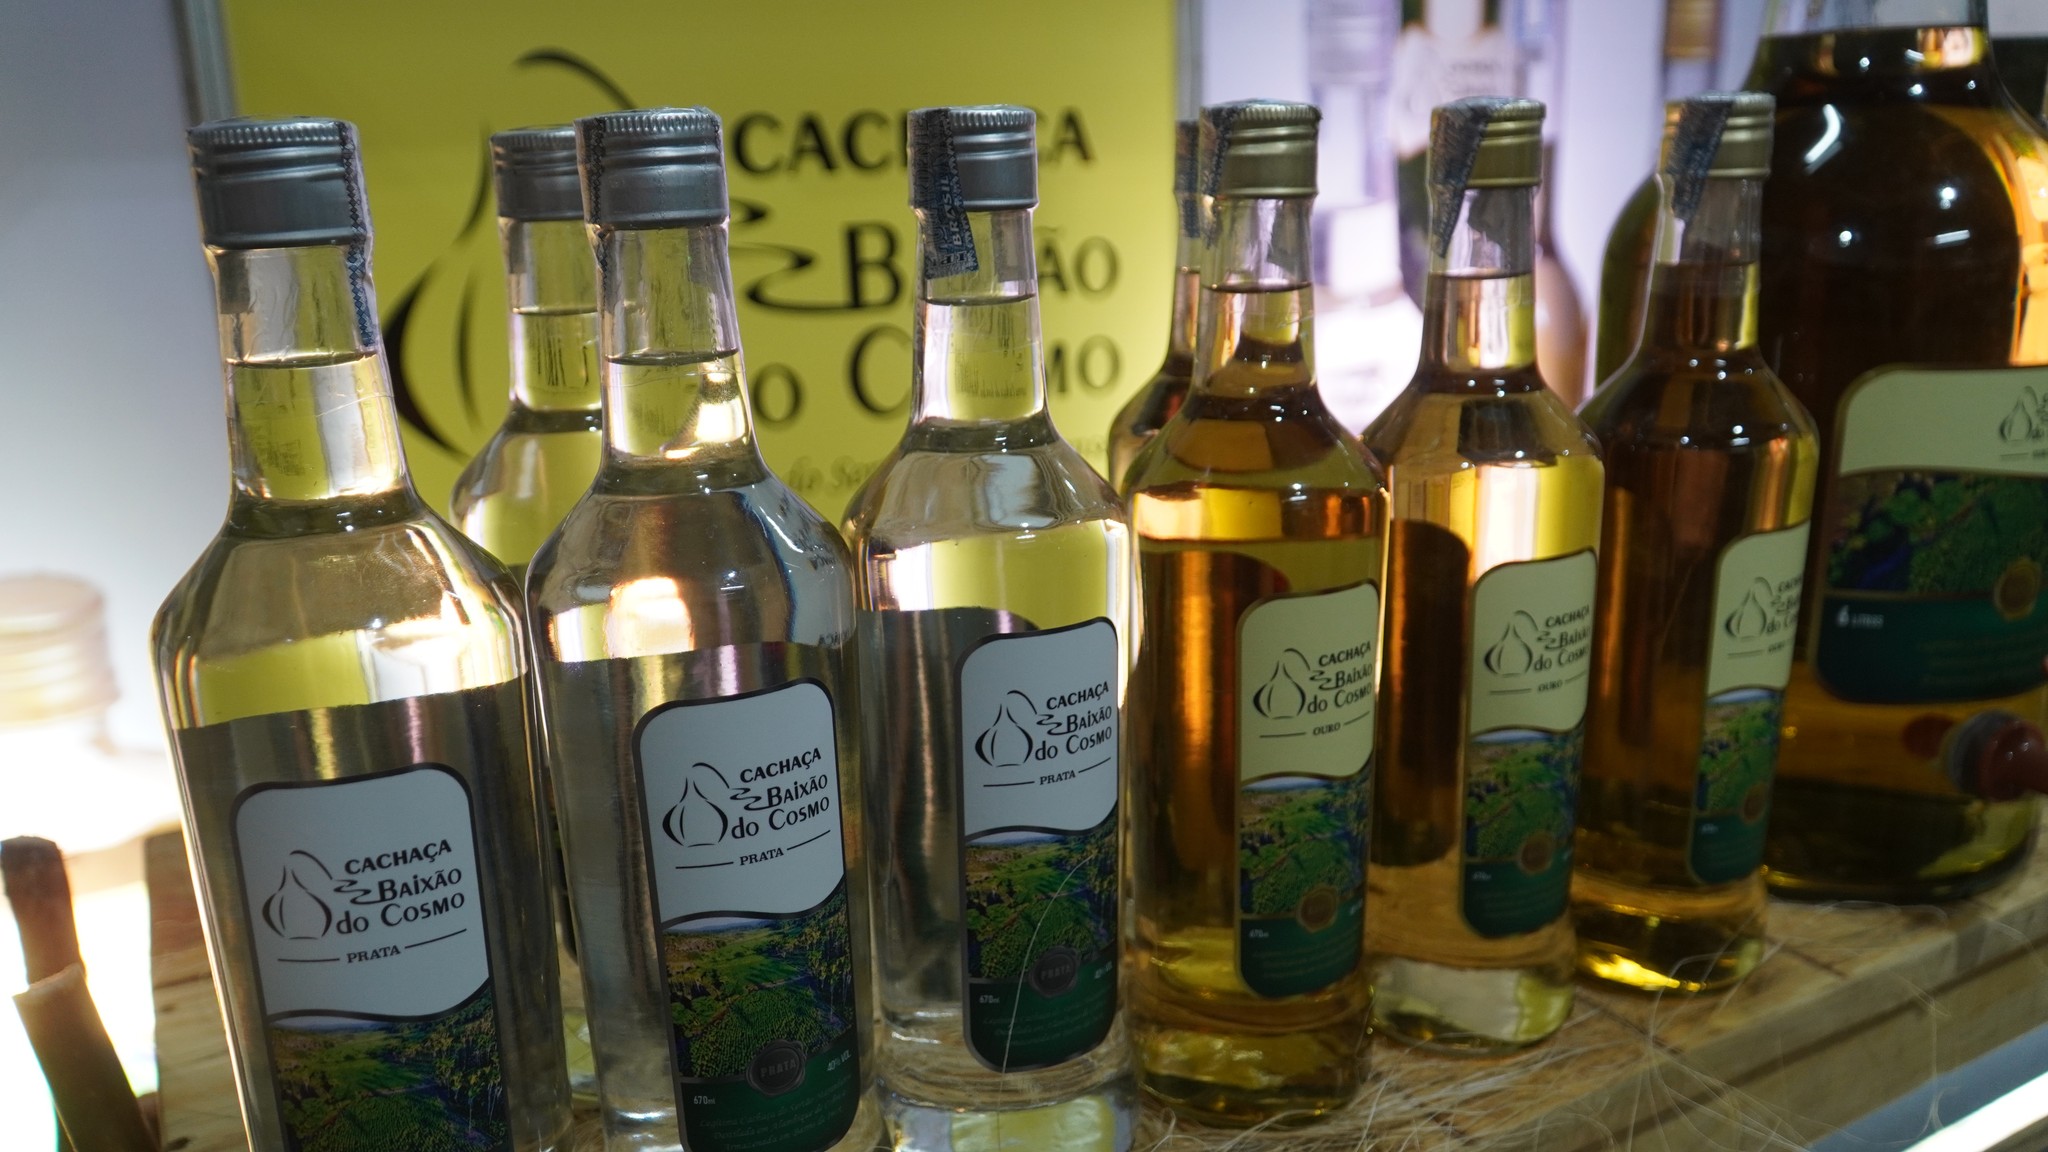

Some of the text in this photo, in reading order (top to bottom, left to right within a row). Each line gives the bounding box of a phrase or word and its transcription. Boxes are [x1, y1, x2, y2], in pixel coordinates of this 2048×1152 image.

[732, 106, 1094, 176] CACA
[1318, 641, 1372, 668] CACHAÇA
[1534, 654, 1553, 671] do
[1046, 681, 1109, 710] CACHAÇA
[1307, 682, 1373, 714] do COSMO
[1035, 726, 1112, 761] do COSMO
[1312, 722, 1341, 736] OURO
[740, 748, 822, 784] CACHAÇA
[1039, 770, 1076, 785] PRATA
[731, 796, 830, 839] do COSMO
[344, 839, 452, 876] CACHAÇA
[739, 848, 784, 866] PRATA
[336, 892, 465, 935] do COSMO
[346, 945, 401, 964] PRATA
[760, 1058, 798, 1078] PRATA
